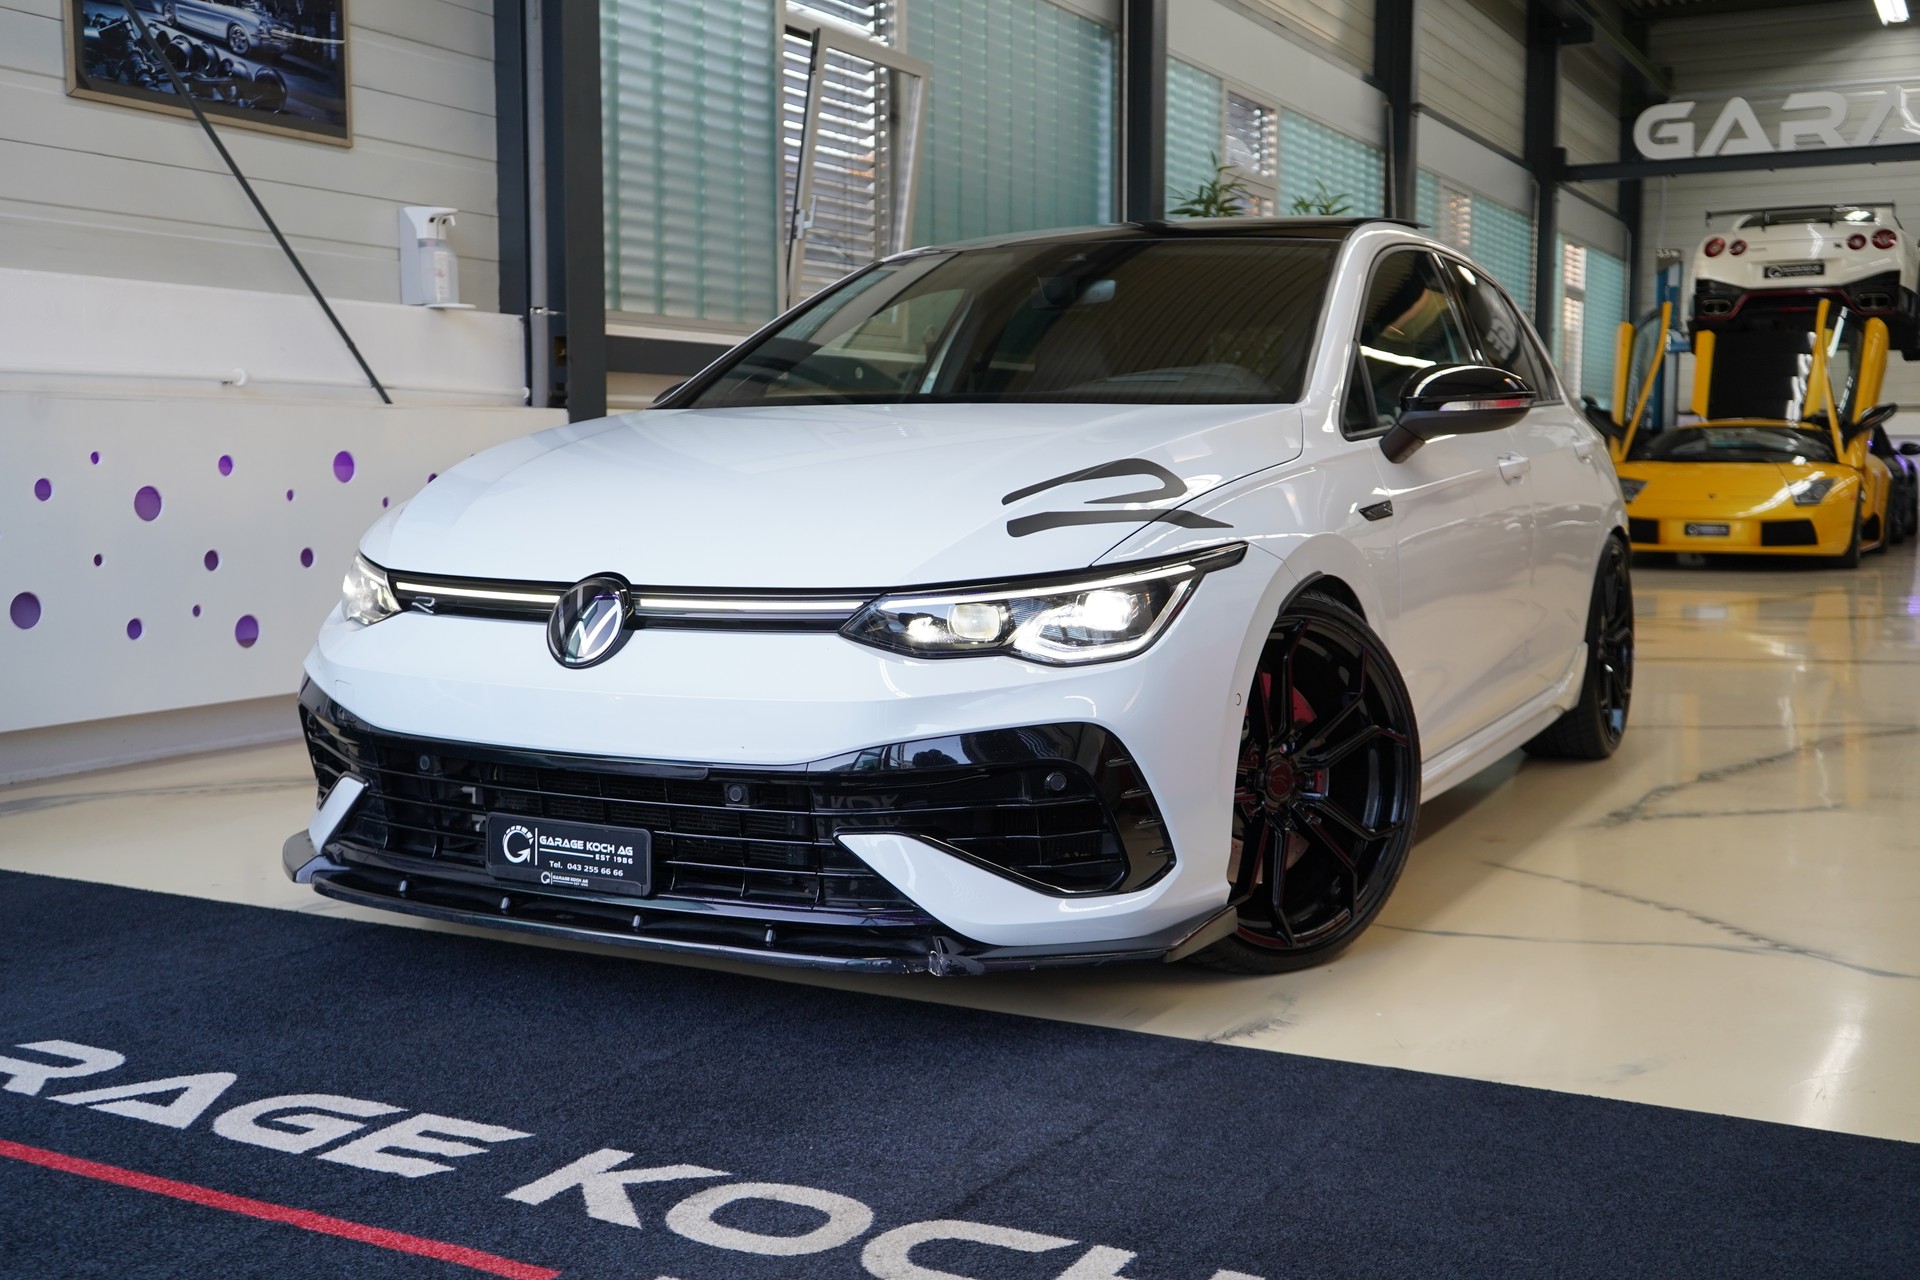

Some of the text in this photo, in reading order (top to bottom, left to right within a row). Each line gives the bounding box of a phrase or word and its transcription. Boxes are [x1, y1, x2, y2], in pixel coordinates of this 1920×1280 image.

[539, 835, 634, 856] GARAGE KOCH AG
[549, 860, 624, 877] Tel. 043 255 66 66
[595, 853, 634, 865] EST 1986
[0, 1040, 1266, 1280] RAGE KOC
